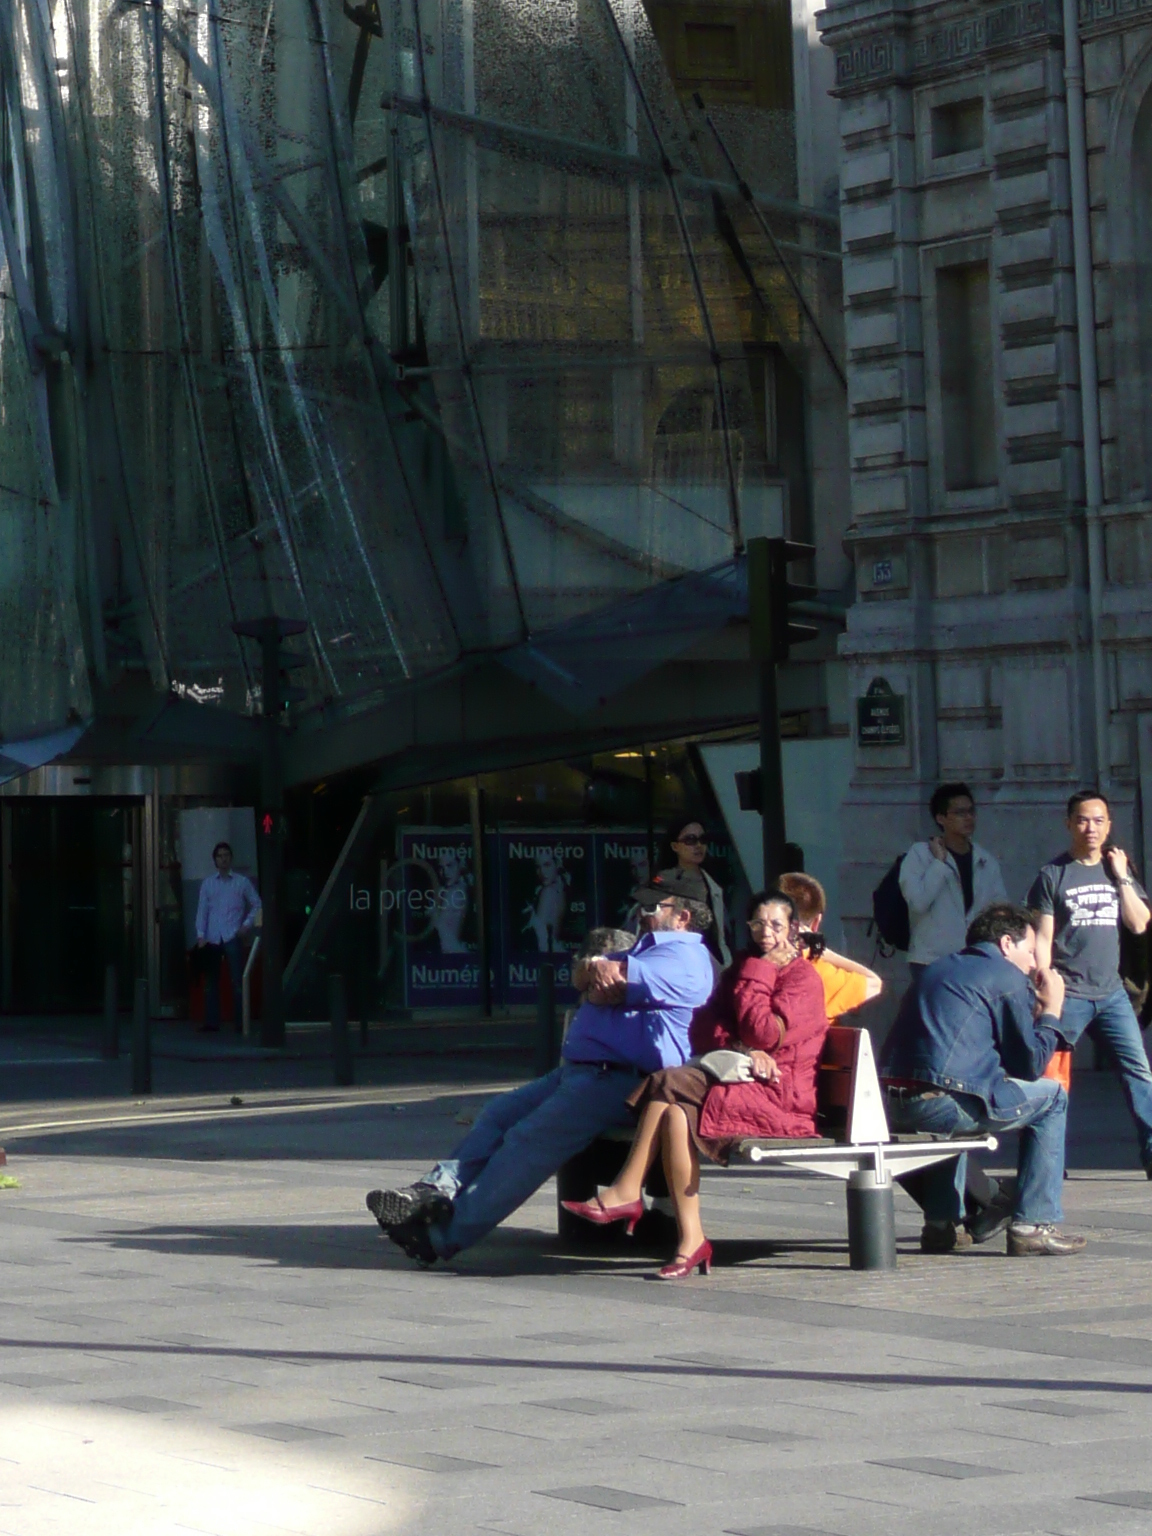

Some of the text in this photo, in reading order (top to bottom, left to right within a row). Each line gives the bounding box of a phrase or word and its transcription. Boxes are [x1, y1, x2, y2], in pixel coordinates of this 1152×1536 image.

[411, 842, 473, 859] Numér
[509, 842, 584, 859] Numéro
[349, 883, 467, 915] la presse
